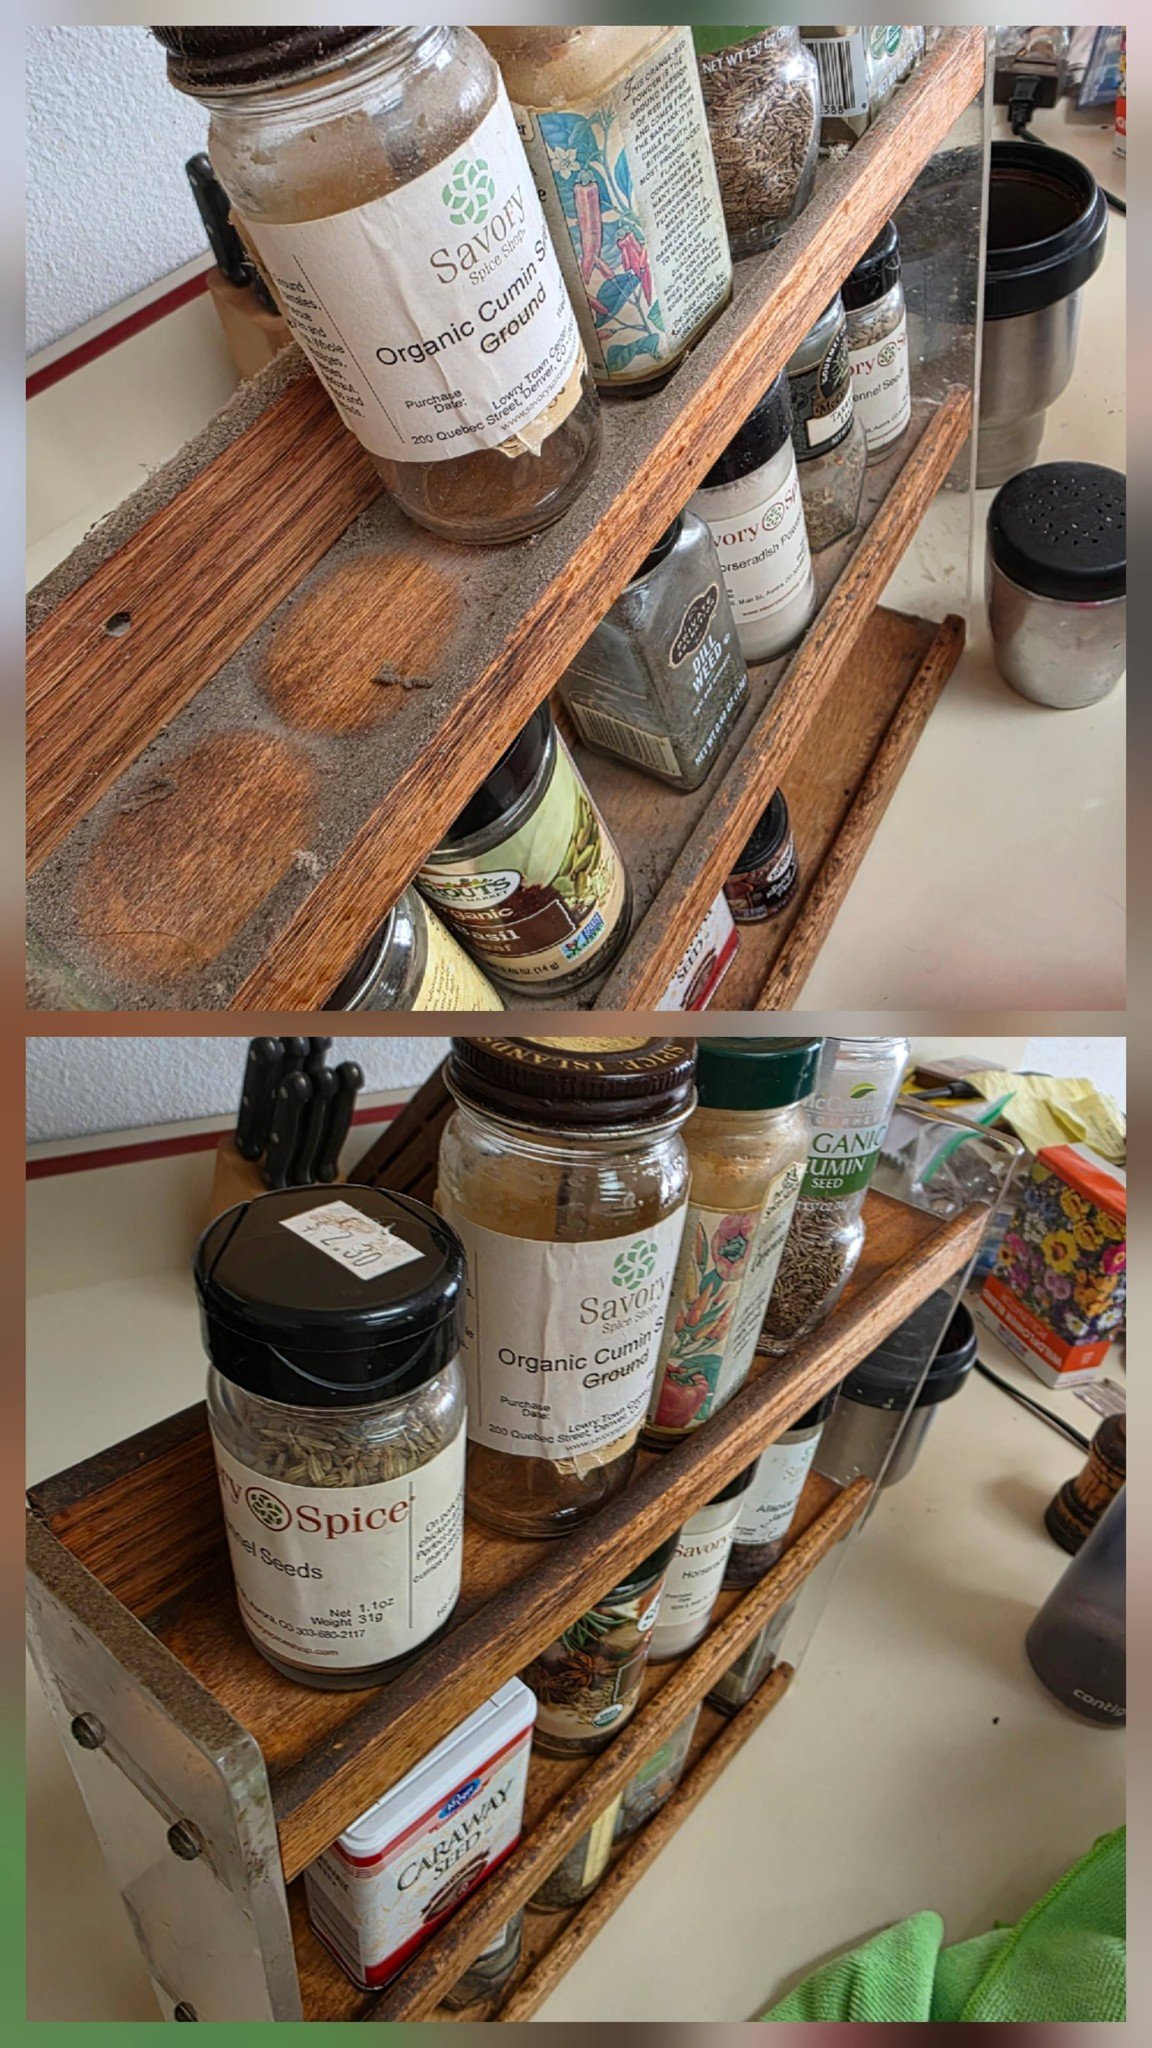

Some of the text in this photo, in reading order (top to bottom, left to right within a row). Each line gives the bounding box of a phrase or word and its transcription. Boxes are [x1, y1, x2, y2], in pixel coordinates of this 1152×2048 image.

[669, 56, 682, 71] THE
[702, 58, 723, 74] NET
[725, 50, 744, 67] WT
[629, 63, 687, 120] GROUND VERSION
[636, 76, 686, 127] OF RED PEPPER
[634, 83, 691, 142] AND COMES FROM
[634, 136, 648, 154] THE
[641, 137, 662, 160] CHILE
[678, 113, 685, 124] IT
[671, 123, 687, 144] WITH
[688, 119, 692, 128] A
[639, 122, 700, 186] MOST PRONOUNCED
[649, 147, 698, 200] CONSIDERED BY
[651, 157, 700, 209] MANY CHEFS AN
[691, 175, 703, 193] FOR
[664, 191, 698, 230] MEATS AND
[701, 194, 707, 203] A
[430, 185, 525, 284] Savory
[655, 240, 672, 263] DASH
[672, 226, 685, 244] CAN
[685, 212, 698, 230] ADD
[661, 253, 670, 267] TO
[670, 235, 687, 257] MANY
[469, 255, 502, 285] Spice
[501, 230, 524, 258] Shop
[683, 276, 696, 295] AND
[376, 321, 474, 366] Organic
[478, 262, 537, 322] Cumin
[480, 282, 547, 354] Ground
[405, 389, 463, 409] Purchase
[492, 383, 523, 410] Lowry
[525, 359, 549, 383] Town
[852, 385, 882, 402] ennel
[411, 435, 433, 445] 200
[436, 420, 485, 441] Quebec
[486, 400, 523, 426] Street,
[434, 398, 467, 413] Date:
[712, 522, 759, 549] vory
[719, 543, 779, 573] orseradish
[692, 634, 716, 674] DILL
[692, 642, 723, 693] WEED
[694, 748, 708, 766] NET
[706, 731, 717, 749] WT
[441, 907, 514, 921] rganic
[477, 1037, 685, 1072] SPICE ISLANDS
[812, 1125, 886, 1153] GANIC
[811, 1178, 844, 1188] SEED
[580, 1277, 665, 1325] Savory
[602, 1317, 632, 1334] Spice
[499, 1331, 651, 1373] Organic Cumin
[583, 1347, 649, 1388] Ground
[501, 1395, 550, 1412] Purchase
[489, 1424, 507, 1436] 200
[511, 1429, 554, 1443] Quebec
[296, 1499, 408, 1540] Spice
[260, 1547, 324, 1580] Seeds
[310, 1612, 383, 1627] Weight 31g
[330, 1608, 351, 1617] Net
[295, 1627, 366, 1640] 303-680-2117
[1073, 1688, 1126, 1717] contig
[398, 1777, 514, 1891] CARAWAY
[433, 1831, 481, 1880] SEED
